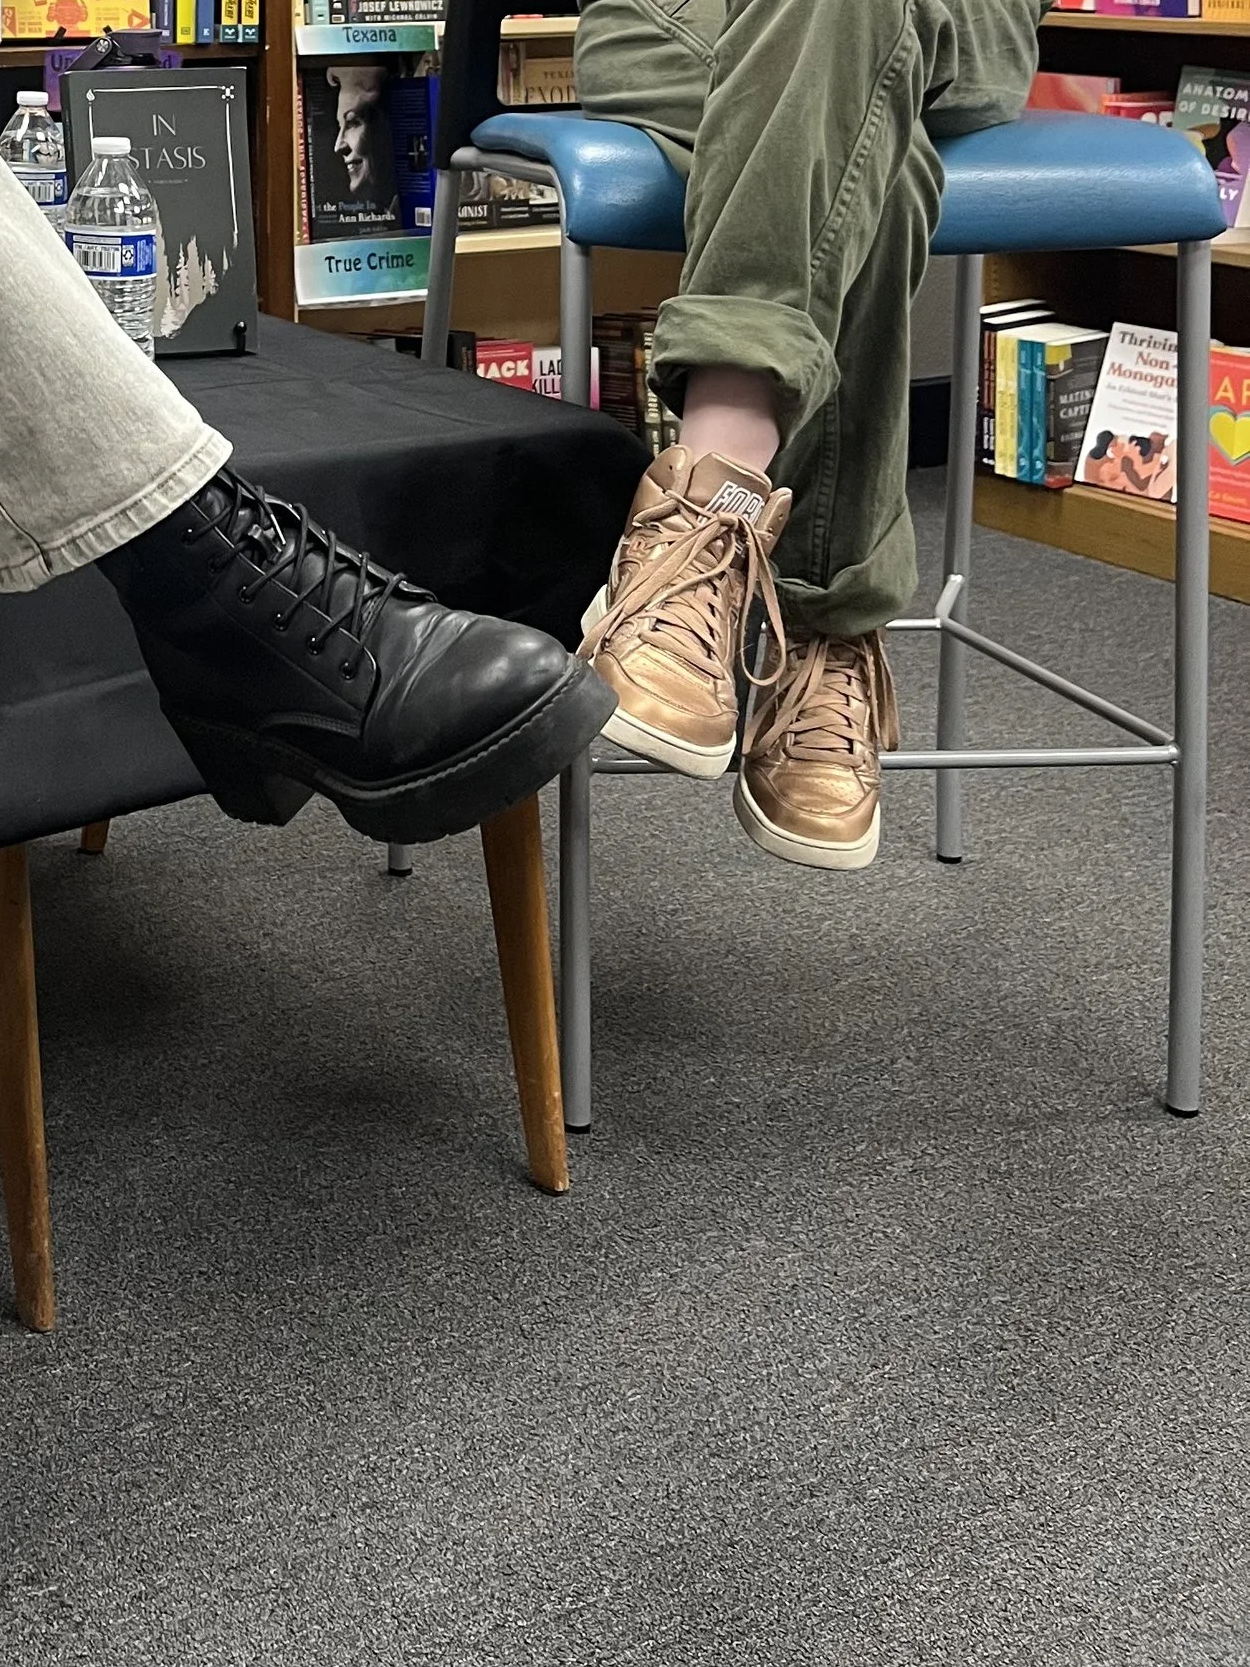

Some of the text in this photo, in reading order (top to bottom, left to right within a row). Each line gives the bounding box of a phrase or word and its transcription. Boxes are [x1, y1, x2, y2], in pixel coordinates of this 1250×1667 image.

[358, 0, 444, 13] JOSEF LEWKOWICZ
[342, 26, 398, 43] Texana
[1178, 101, 1196, 114] OF
[152, 113, 177, 136] IN
[131, 145, 207, 171] STASIS
[323, 202, 337, 212] the
[338, 211, 397, 223] Ann Richards
[325, 252, 415, 273] True Crime
